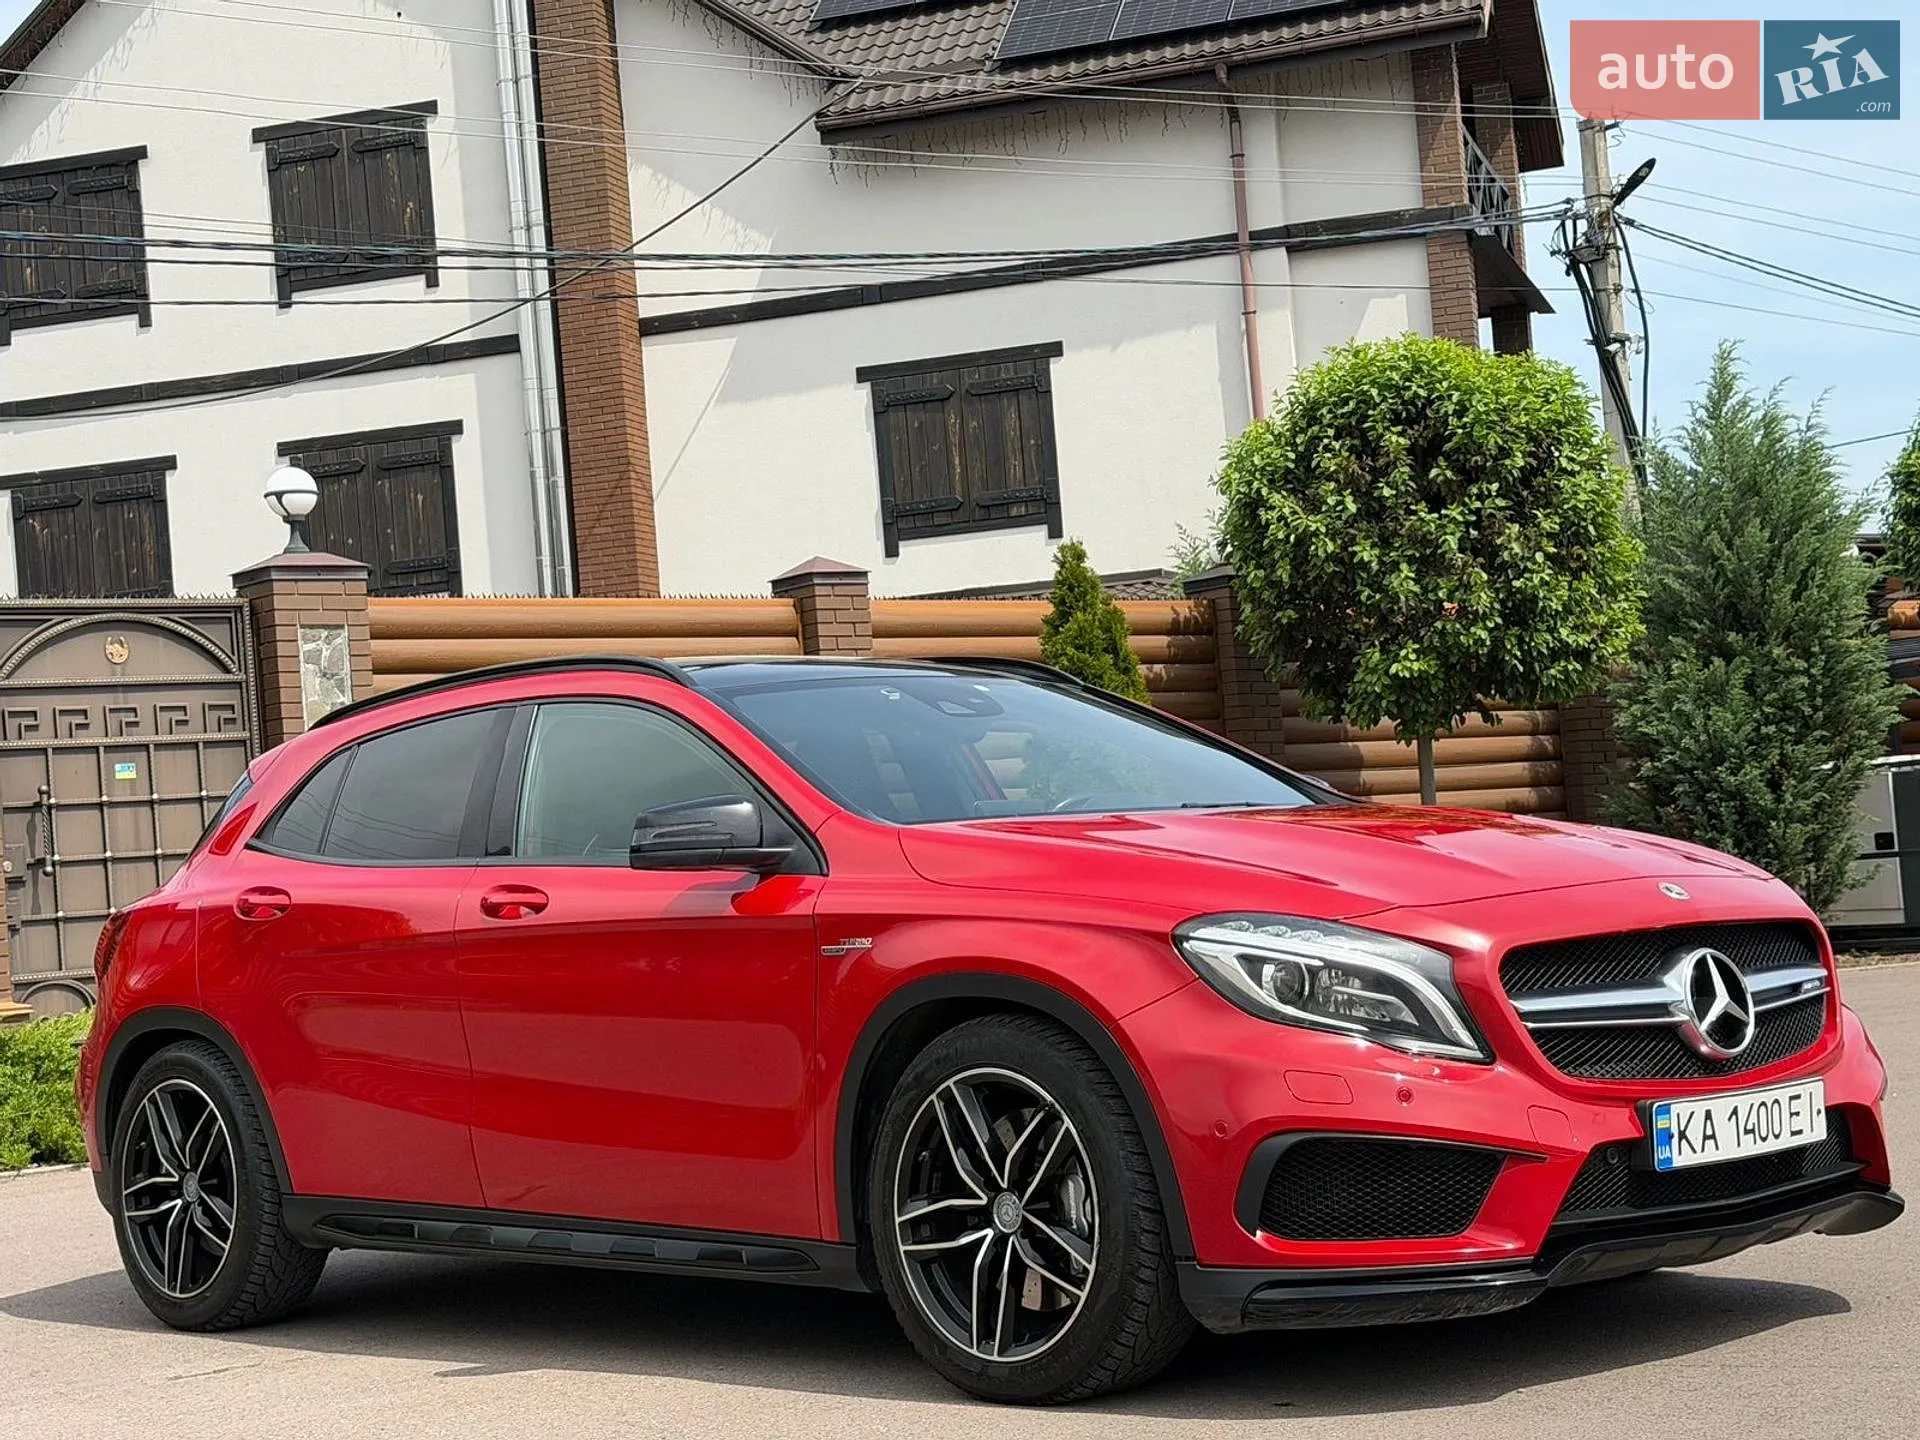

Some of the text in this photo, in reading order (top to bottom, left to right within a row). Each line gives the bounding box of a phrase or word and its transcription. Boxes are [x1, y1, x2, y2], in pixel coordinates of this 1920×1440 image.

[1676, 1091, 1814, 1156] KA 1400 EI
[1658, 1144, 1672, 1160] UA
